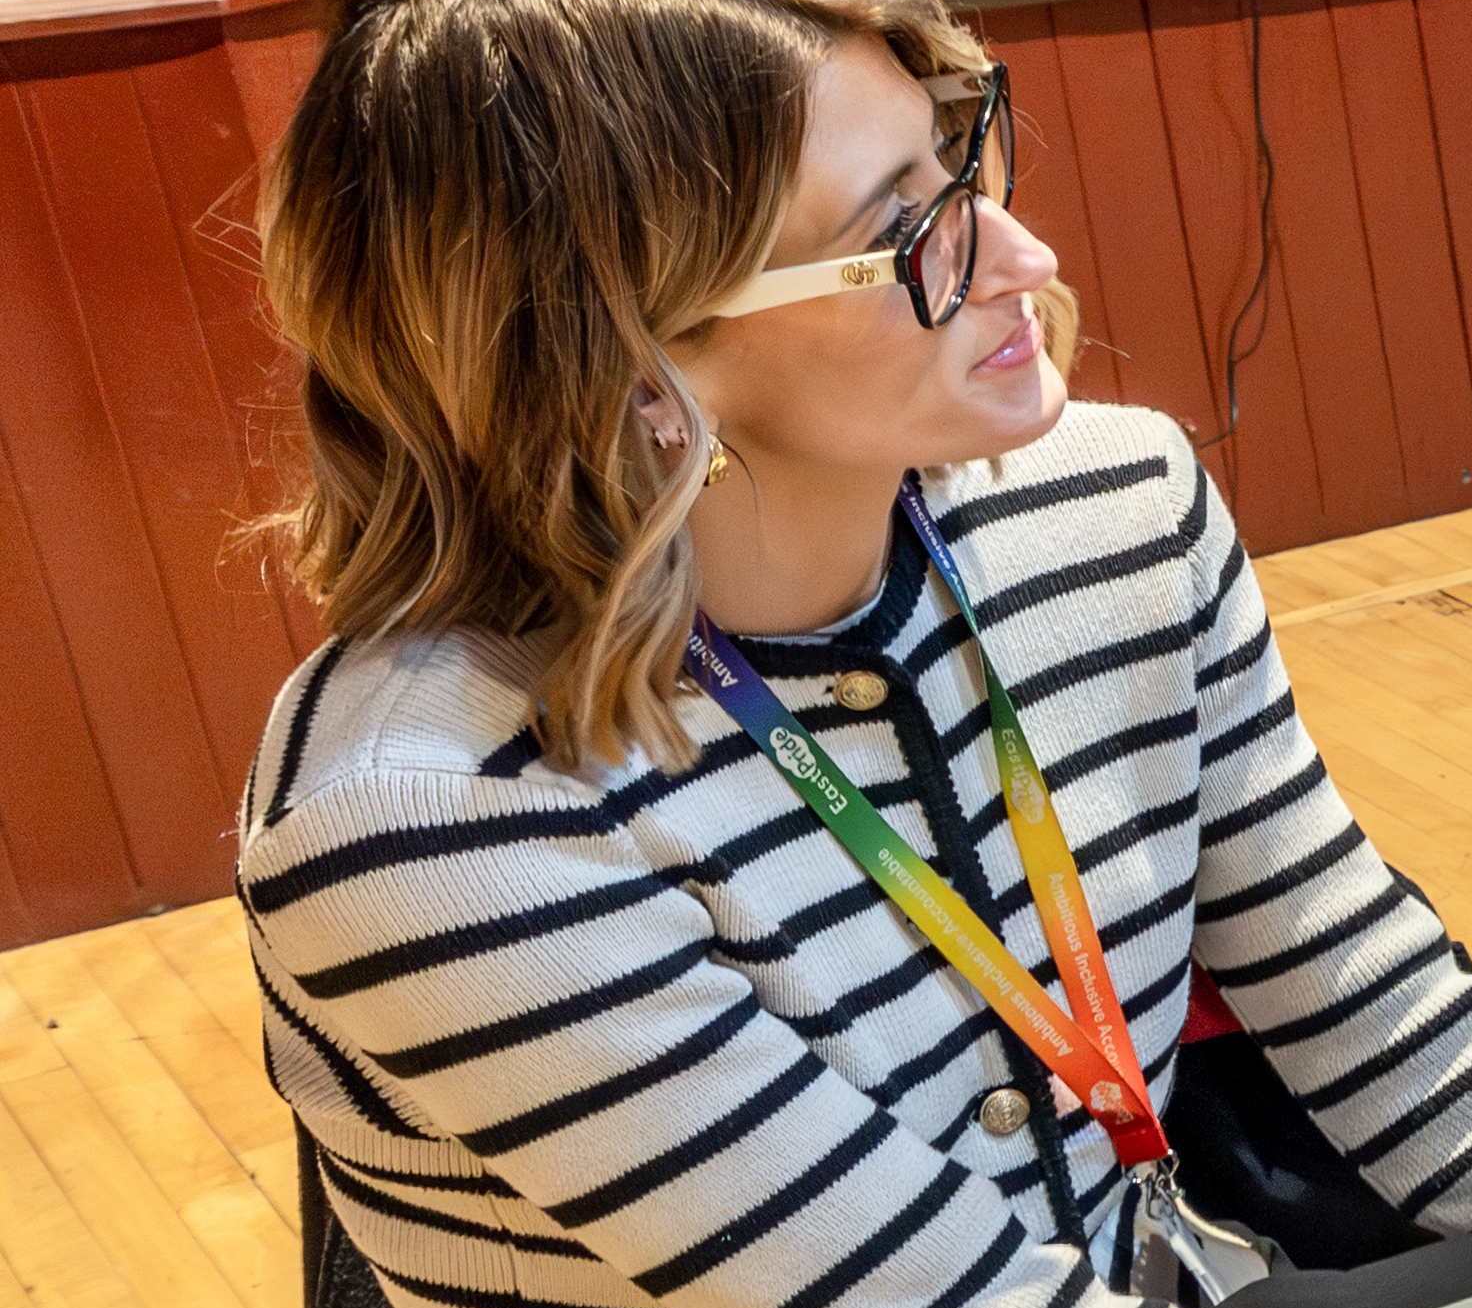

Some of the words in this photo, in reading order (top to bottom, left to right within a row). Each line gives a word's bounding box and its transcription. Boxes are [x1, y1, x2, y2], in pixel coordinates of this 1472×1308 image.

[908, 495, 951, 570] Inclusive
[687, 630, 738, 689] Ambiti
[774, 727, 847, 815] EastPride
[877, 847, 955, 934] Accountable
[955, 933, 1012, 995] Inclusive
[1049, 872, 1083, 952] Ambitious
[1074, 952, 1106, 1023] Inclusive
[1011, 992, 1074, 1057] Ambitious
